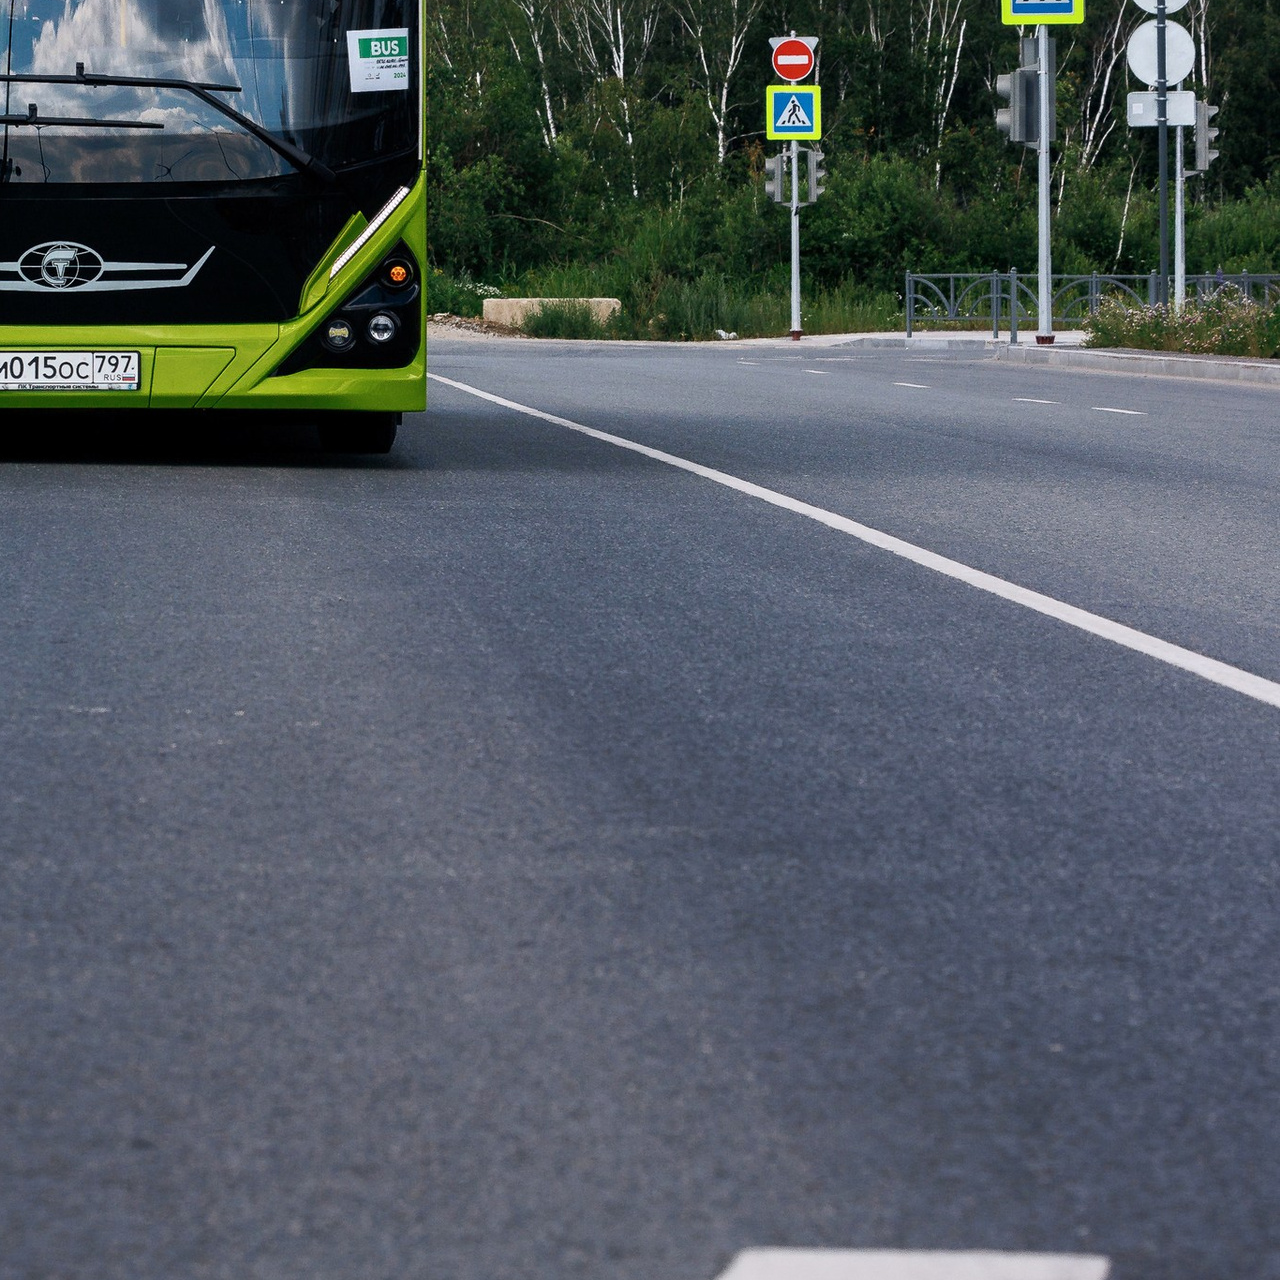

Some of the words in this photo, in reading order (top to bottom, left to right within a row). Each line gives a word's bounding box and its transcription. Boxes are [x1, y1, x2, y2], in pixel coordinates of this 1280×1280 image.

[371, 40, 399, 55] BUS
[95, 355, 132, 373] 797
[103, 373, 122, 381] RUS
